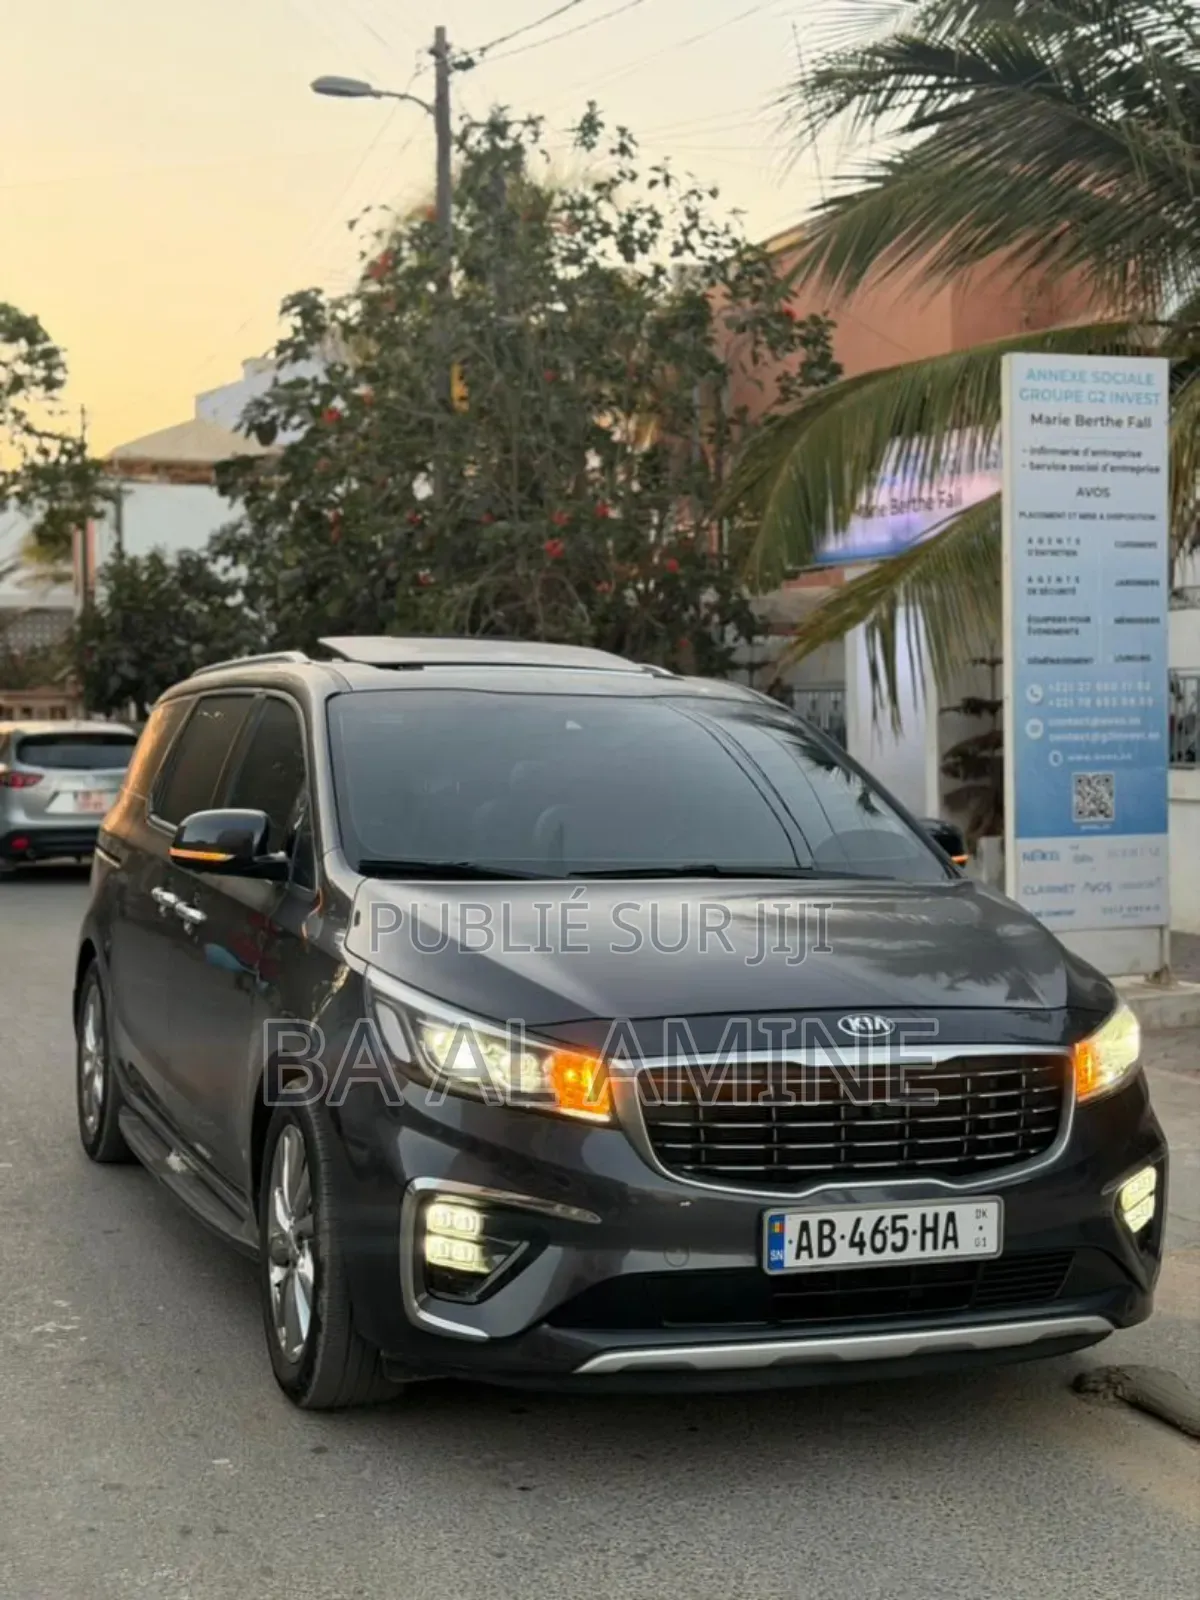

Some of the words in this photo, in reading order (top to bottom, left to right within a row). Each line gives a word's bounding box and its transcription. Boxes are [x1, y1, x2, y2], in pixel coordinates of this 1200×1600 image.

[1090, 370, 1156, 386] SOCIALE
[1019, 387, 1083, 403] GROUPE
[1030, 412, 1071, 427] Marie
[1075, 414, 1124, 428] Berthe
[1127, 415, 1153, 429] Fall
[937, 487, 962, 509] Fall
[1075, 486, 1111, 498] AVOS
[848, 1016, 890, 1031] KIA
